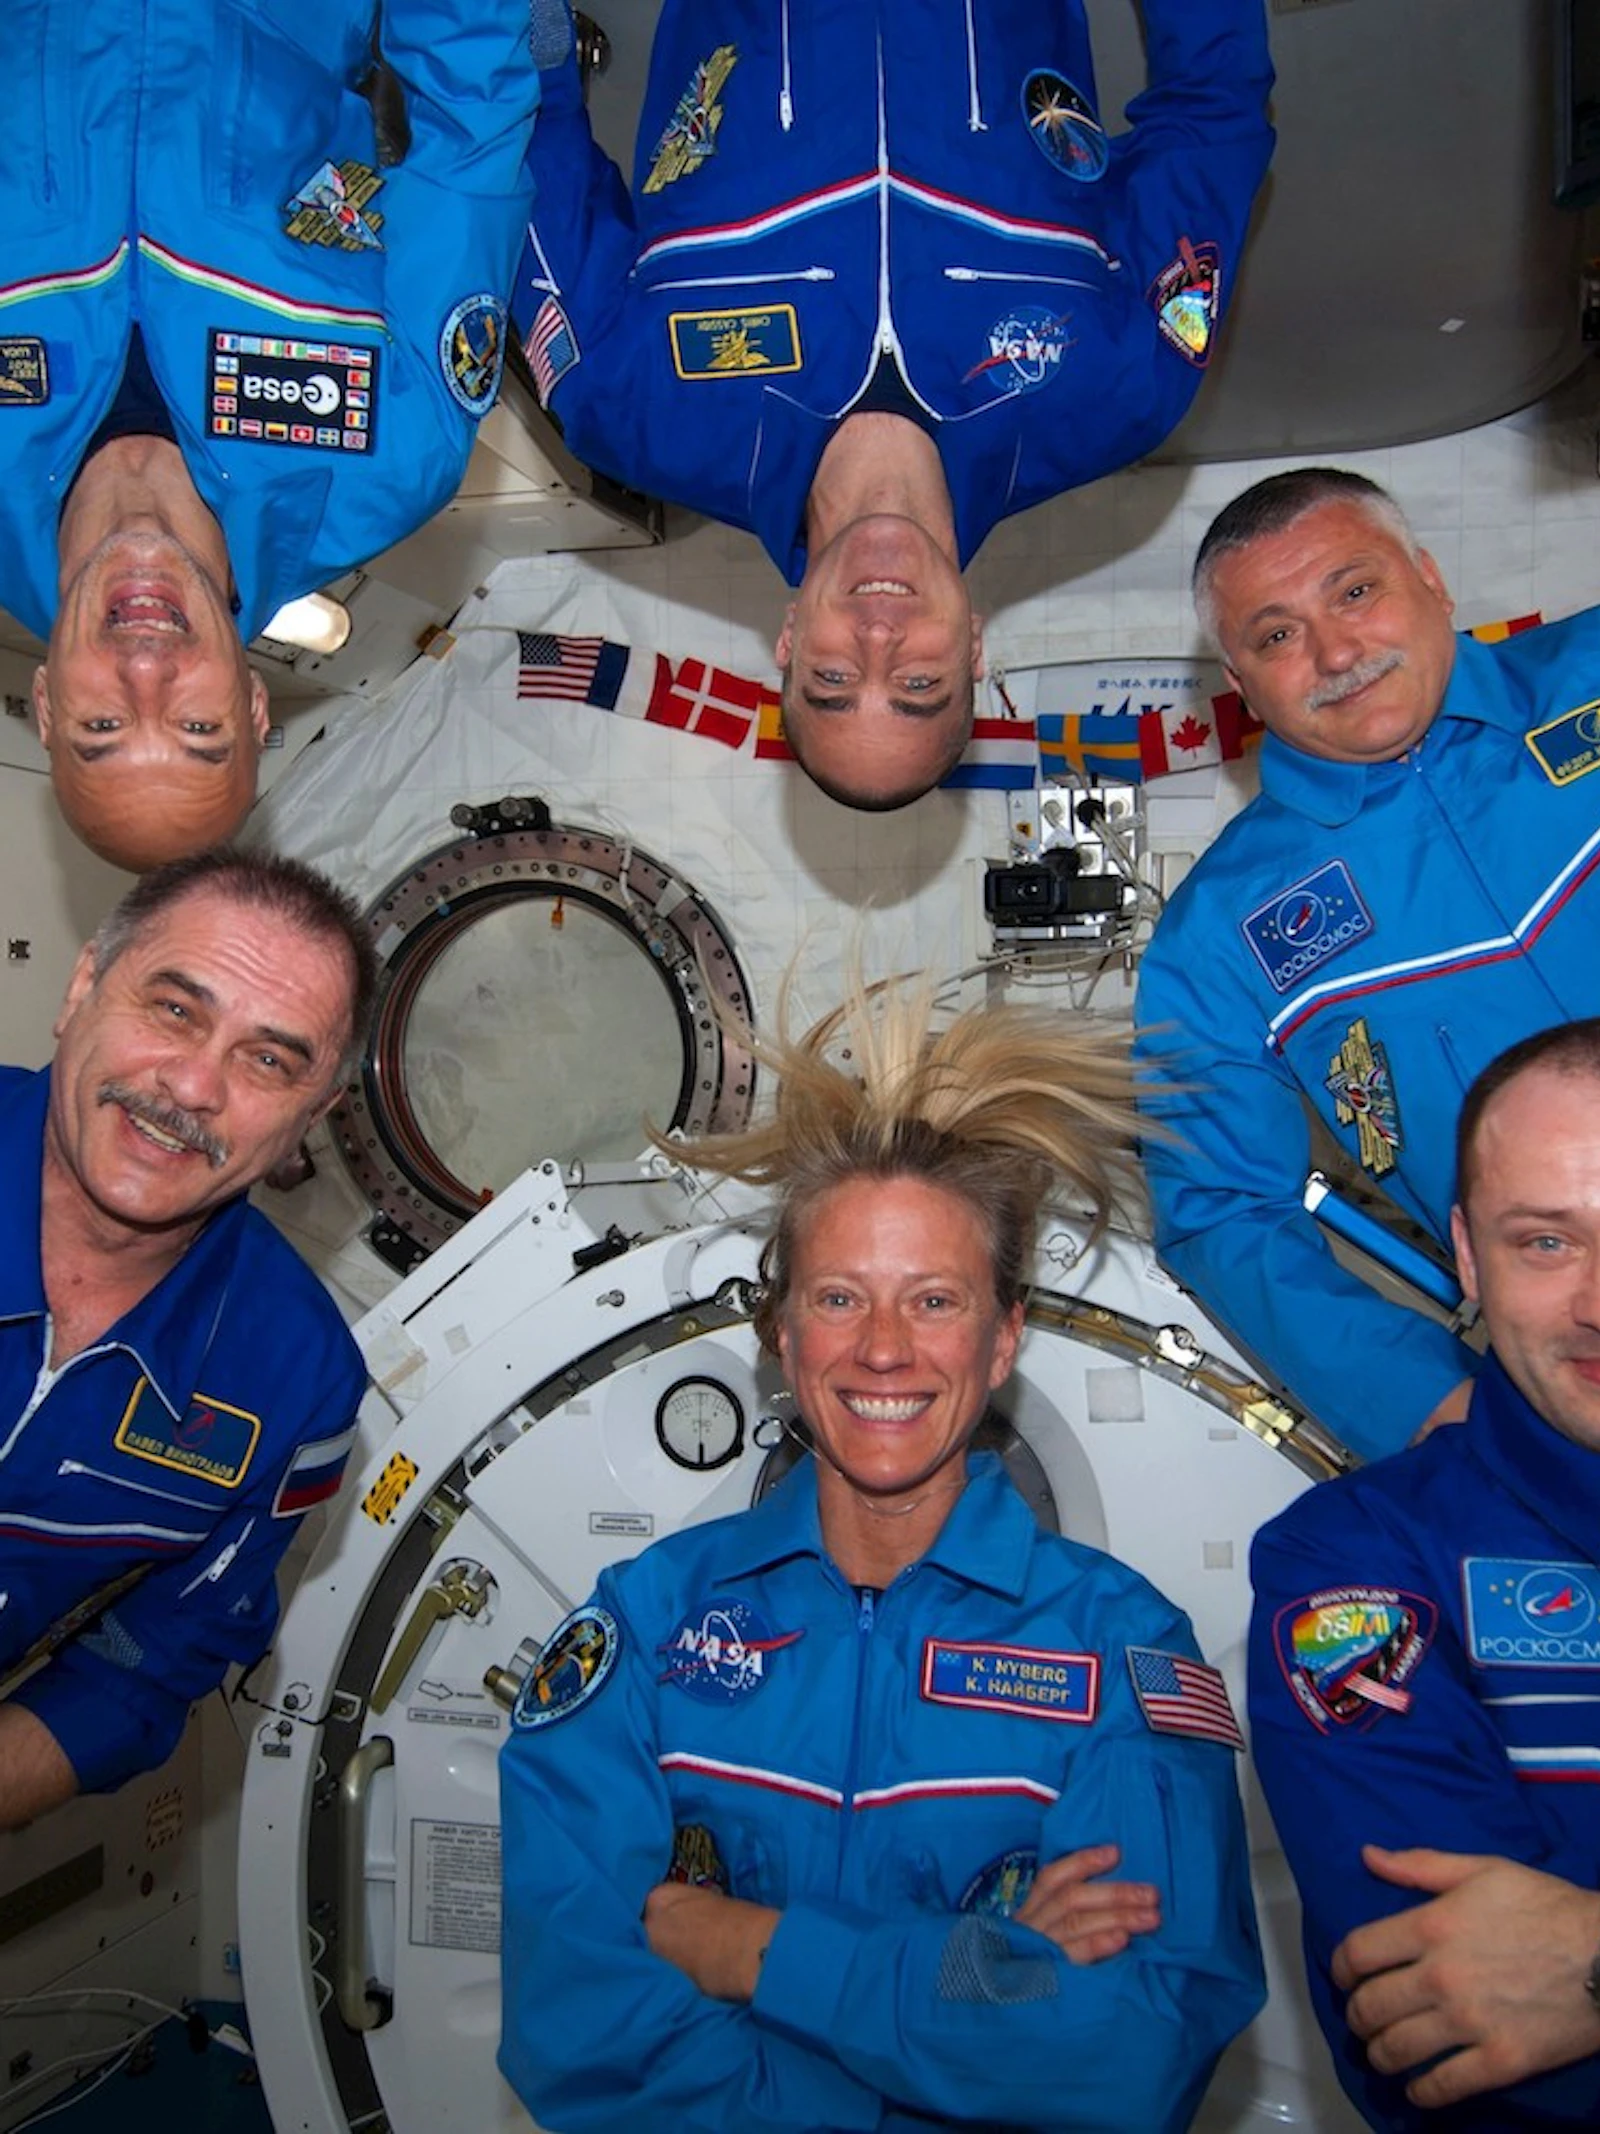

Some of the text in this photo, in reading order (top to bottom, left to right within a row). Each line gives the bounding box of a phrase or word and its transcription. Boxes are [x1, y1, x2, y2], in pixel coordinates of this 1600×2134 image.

[988, 335, 1063, 363] NASA
[243, 374, 301, 403] esa
[1274, 914, 1365, 983] РОСКОСМОС
[676, 1627, 764, 1678] NASA
[971, 1657, 1069, 1685] K. NYBERG
[987, 1678, 1071, 1705] НАЙБЕРГ
